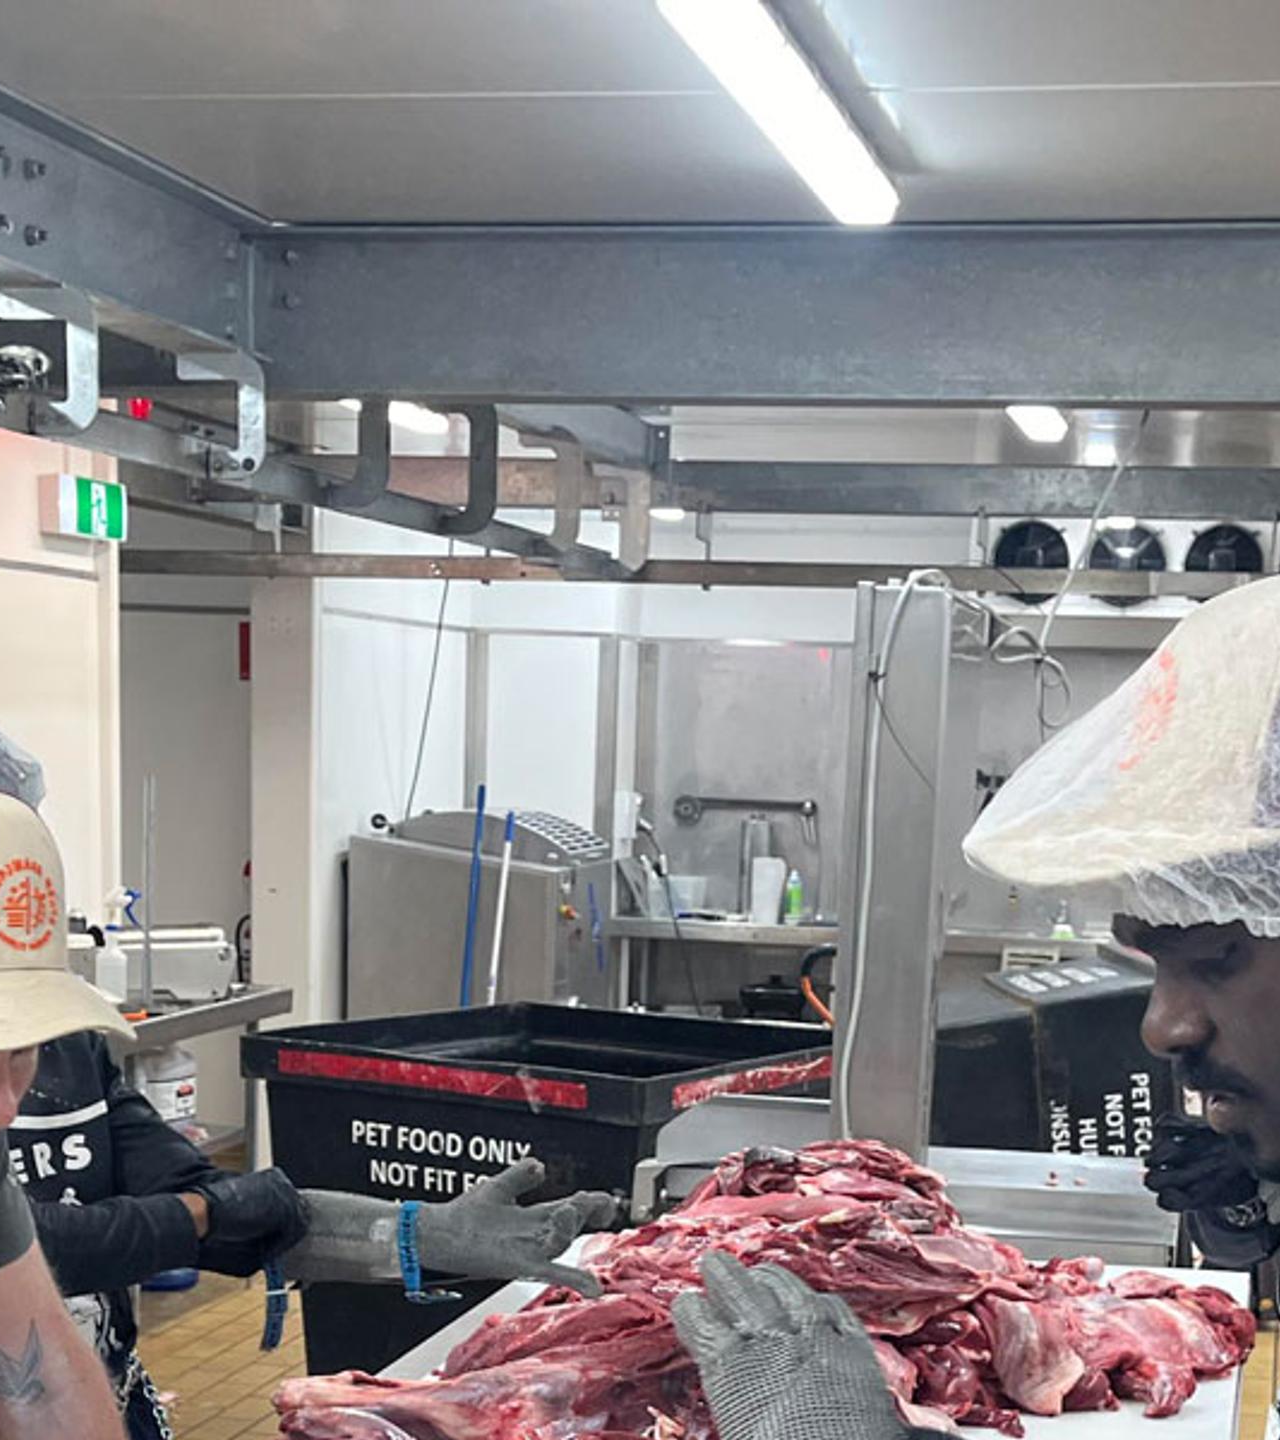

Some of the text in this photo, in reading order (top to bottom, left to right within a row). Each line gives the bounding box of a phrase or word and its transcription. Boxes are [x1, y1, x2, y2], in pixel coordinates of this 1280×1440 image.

[1078, 1117, 1098, 1156] HU
[1104, 1093, 1125, 1139] NOT
[1130, 1072, 1153, 1156] PET FO
[7, 1132, 92, 1185] ERS
[351, 1119, 531, 1166] PET FOOD ONLY
[370, 1159, 418, 1189] NOT
[424, 1167, 457, 1194] FIT
